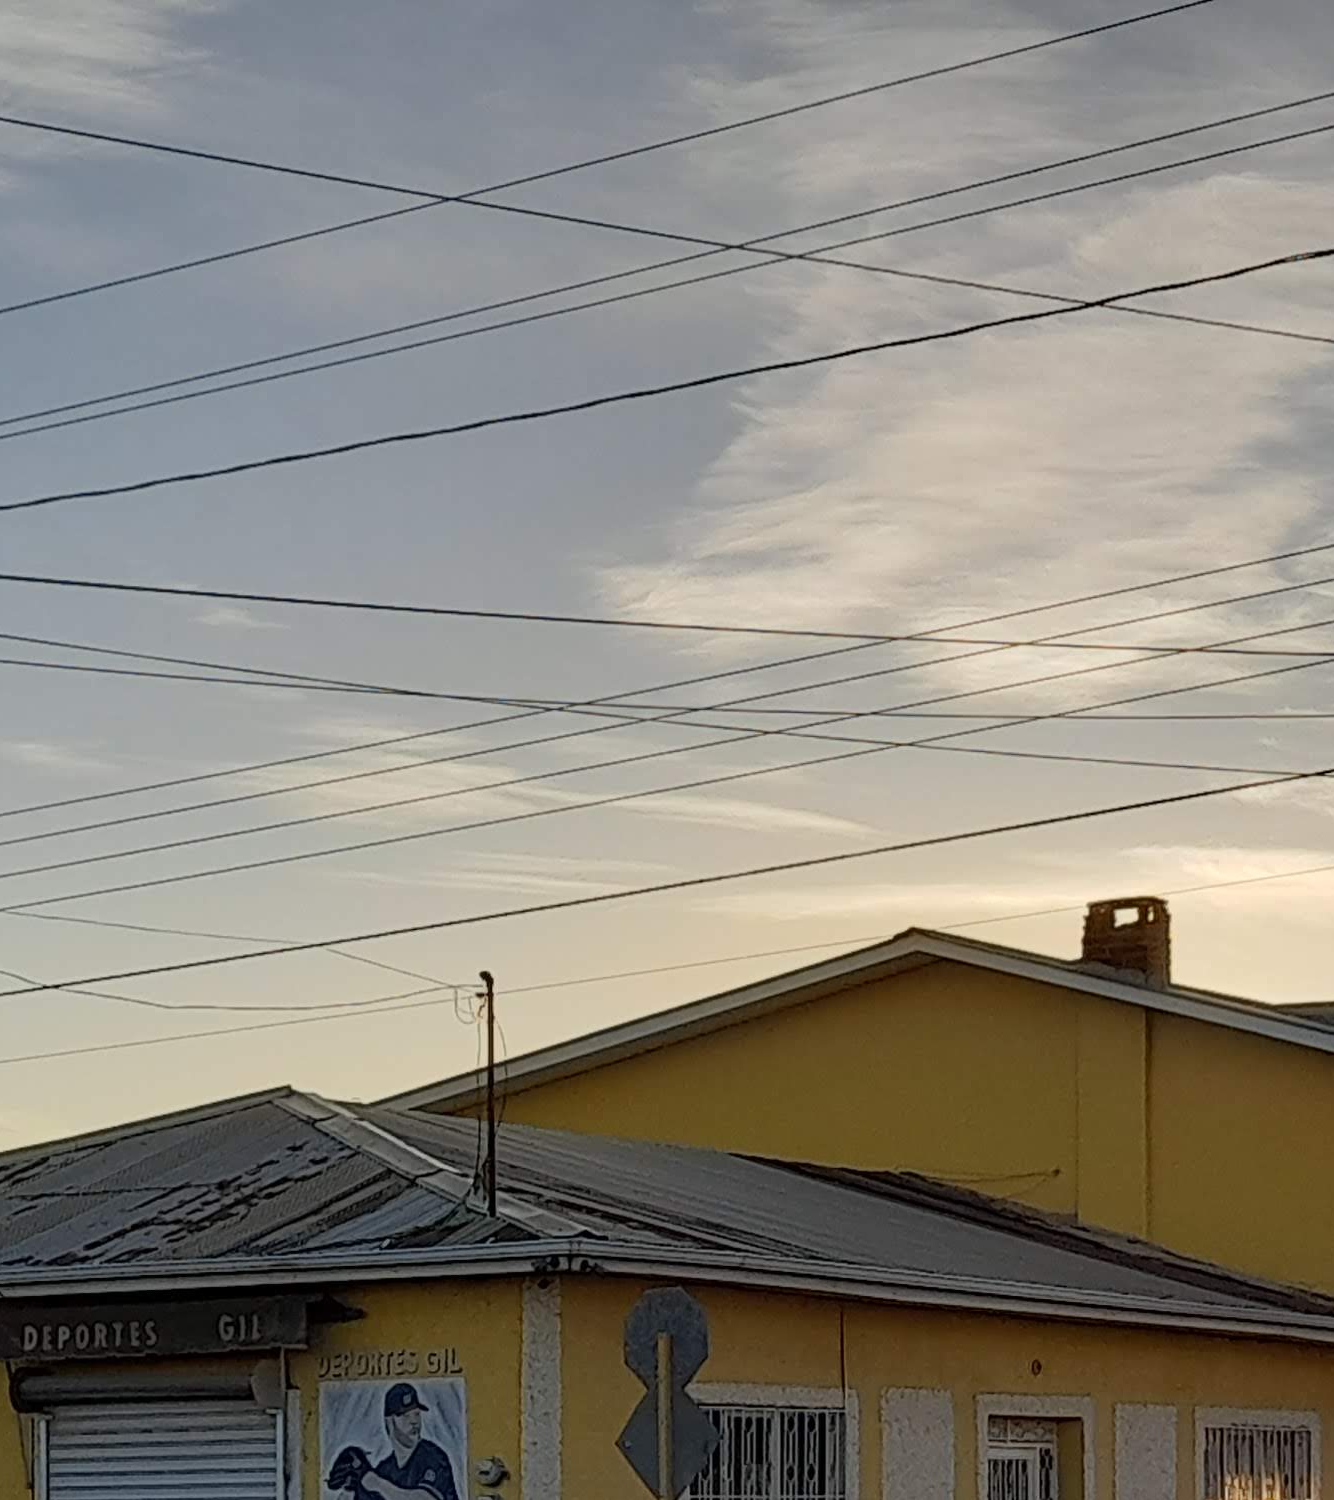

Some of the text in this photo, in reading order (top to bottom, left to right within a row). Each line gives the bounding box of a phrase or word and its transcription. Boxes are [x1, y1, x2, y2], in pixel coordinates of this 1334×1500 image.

[22, 1313, 263, 1352] DEPORTES GIL
[317, 1347, 463, 1378] DEPORTES GIL
